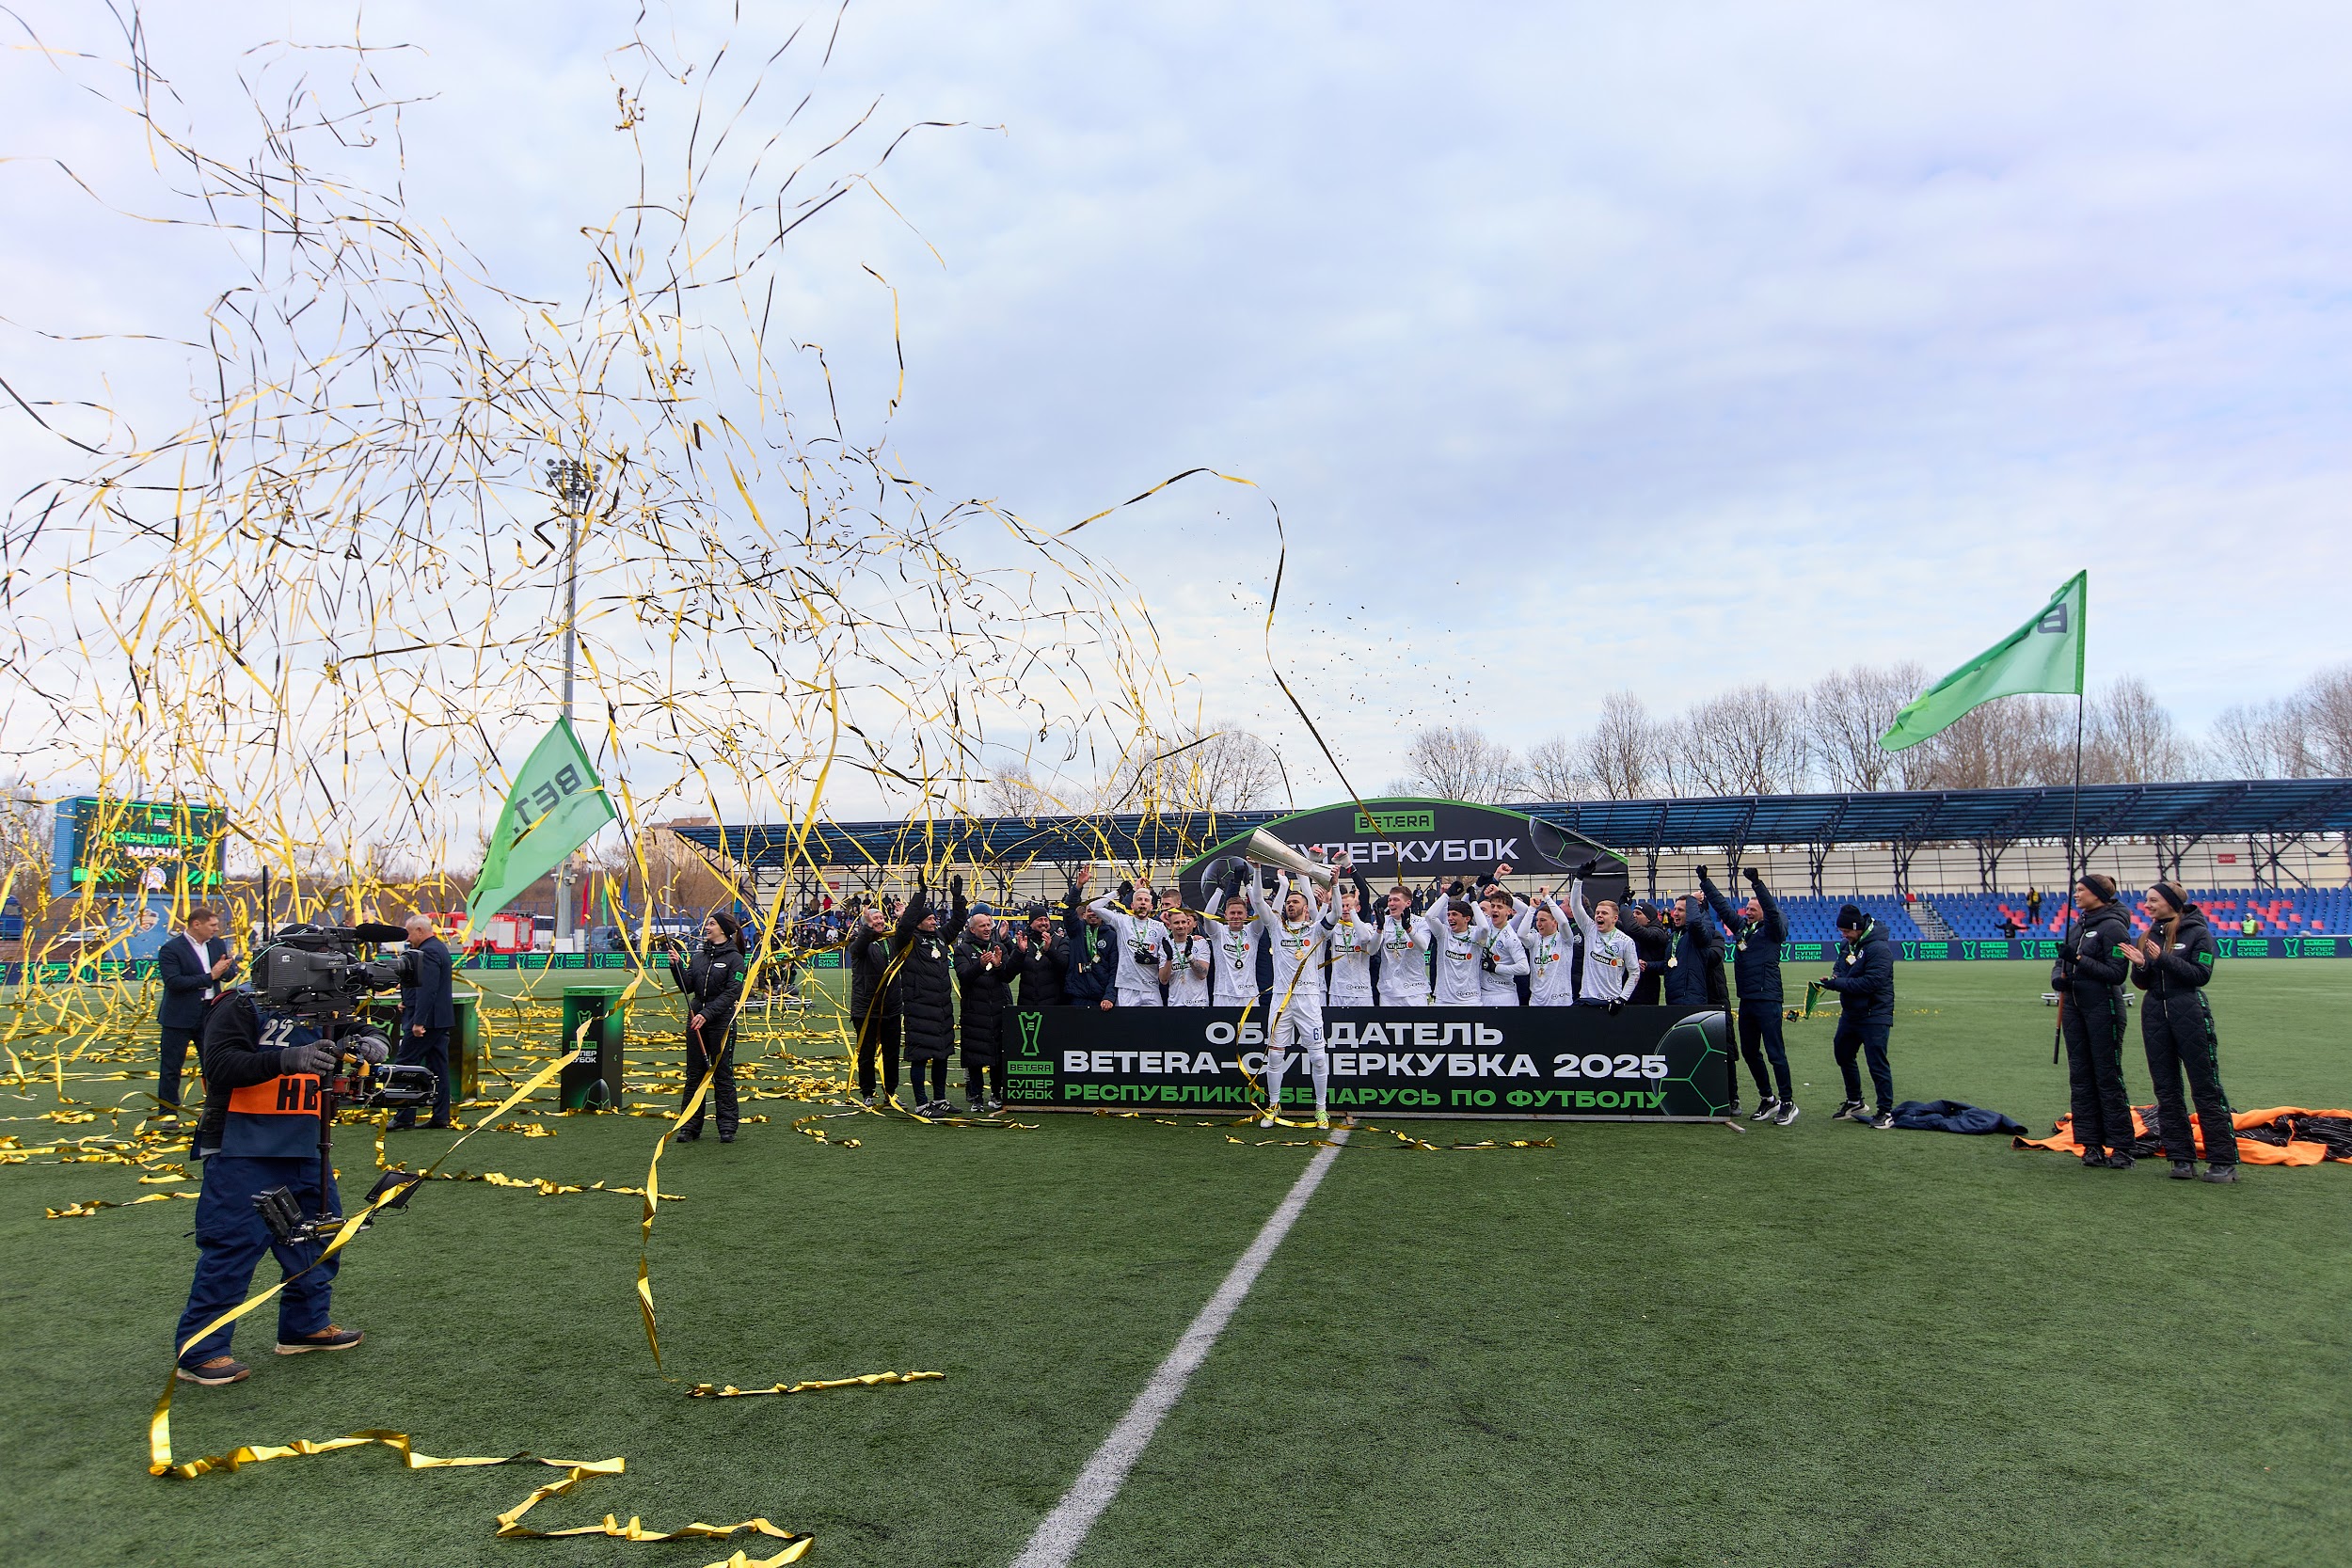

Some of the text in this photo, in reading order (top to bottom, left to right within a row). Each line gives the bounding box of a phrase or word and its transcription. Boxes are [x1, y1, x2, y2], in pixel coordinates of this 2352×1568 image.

[1287, 837, 1520, 864] УПЕРКУБОК
[259, 1018, 294, 1048] 22
[1205, 1022, 1503, 1049] ОБДАТЕЛЬ
[1553, 1053, 1669, 1079] 2025
[1007, 1079, 1055, 1089] СУПЕР
[1007, 1090, 1054, 1100] КУБОК
[1064, 1084, 1265, 1103] РЕСПУБЛИКИ
[1451, 1089, 1497, 1107] ПО
[1505, 1089, 1668, 1109] ФУТБОЛУ
